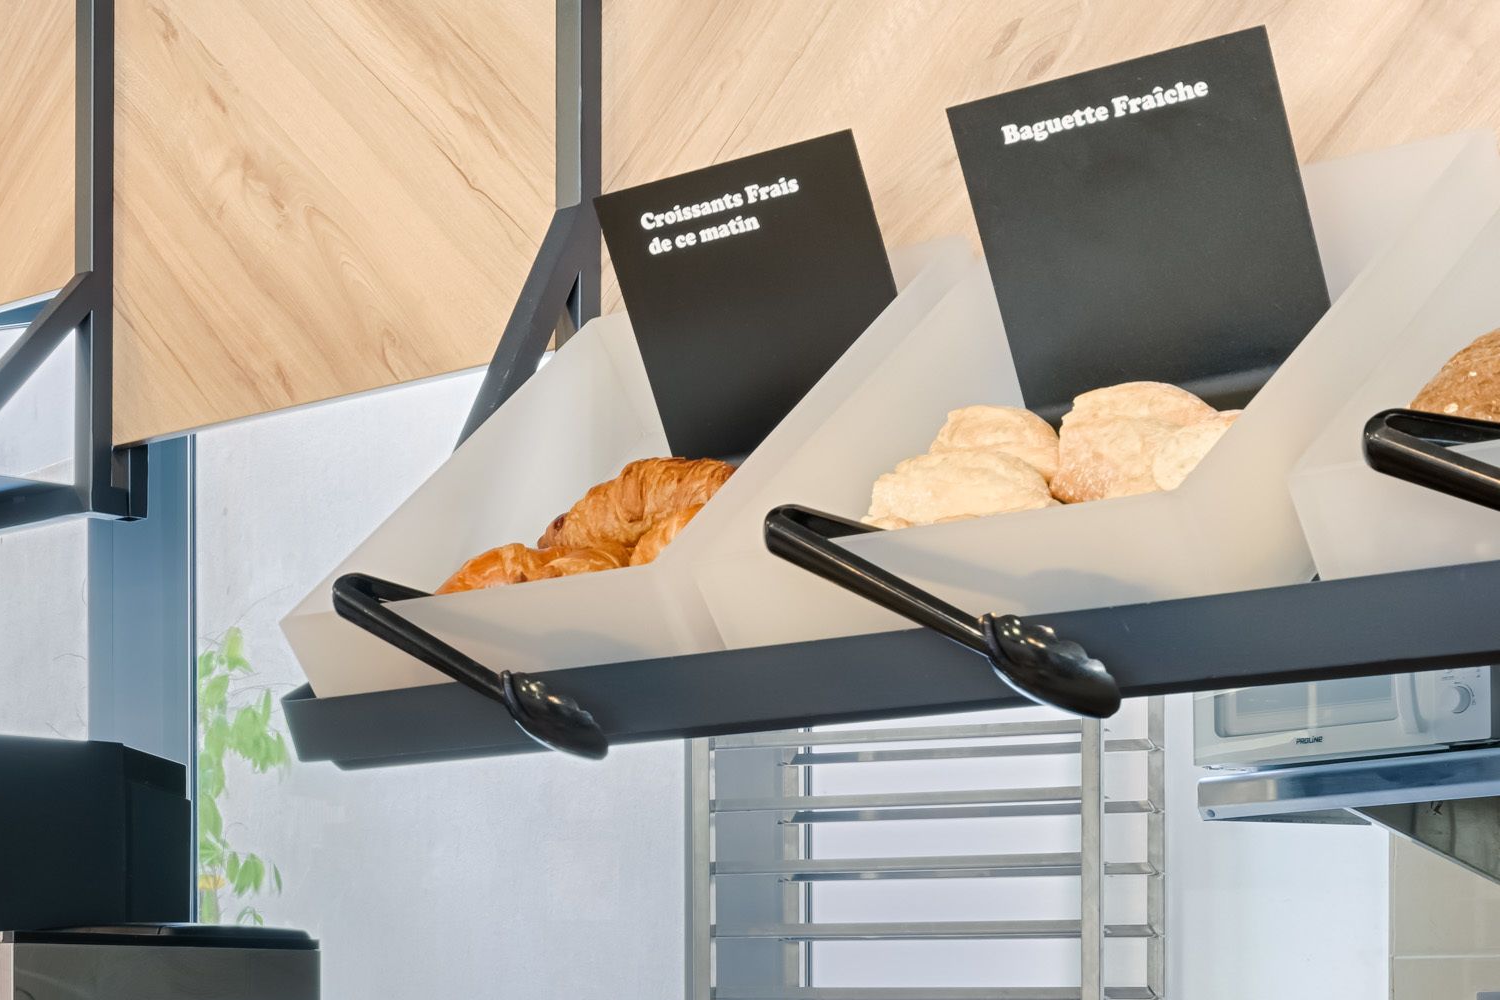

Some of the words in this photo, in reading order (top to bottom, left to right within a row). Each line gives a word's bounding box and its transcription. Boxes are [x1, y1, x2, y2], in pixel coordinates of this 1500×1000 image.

[1000, 105, 1110, 145] Baguette
[1111, 80, 1209, 118] Fraîche
[640, 192, 744, 231] Croissants
[744, 176, 800, 204] Frais
[648, 236, 673, 255] de
[675, 231, 697, 249] ce
[699, 215, 761, 243] matin
